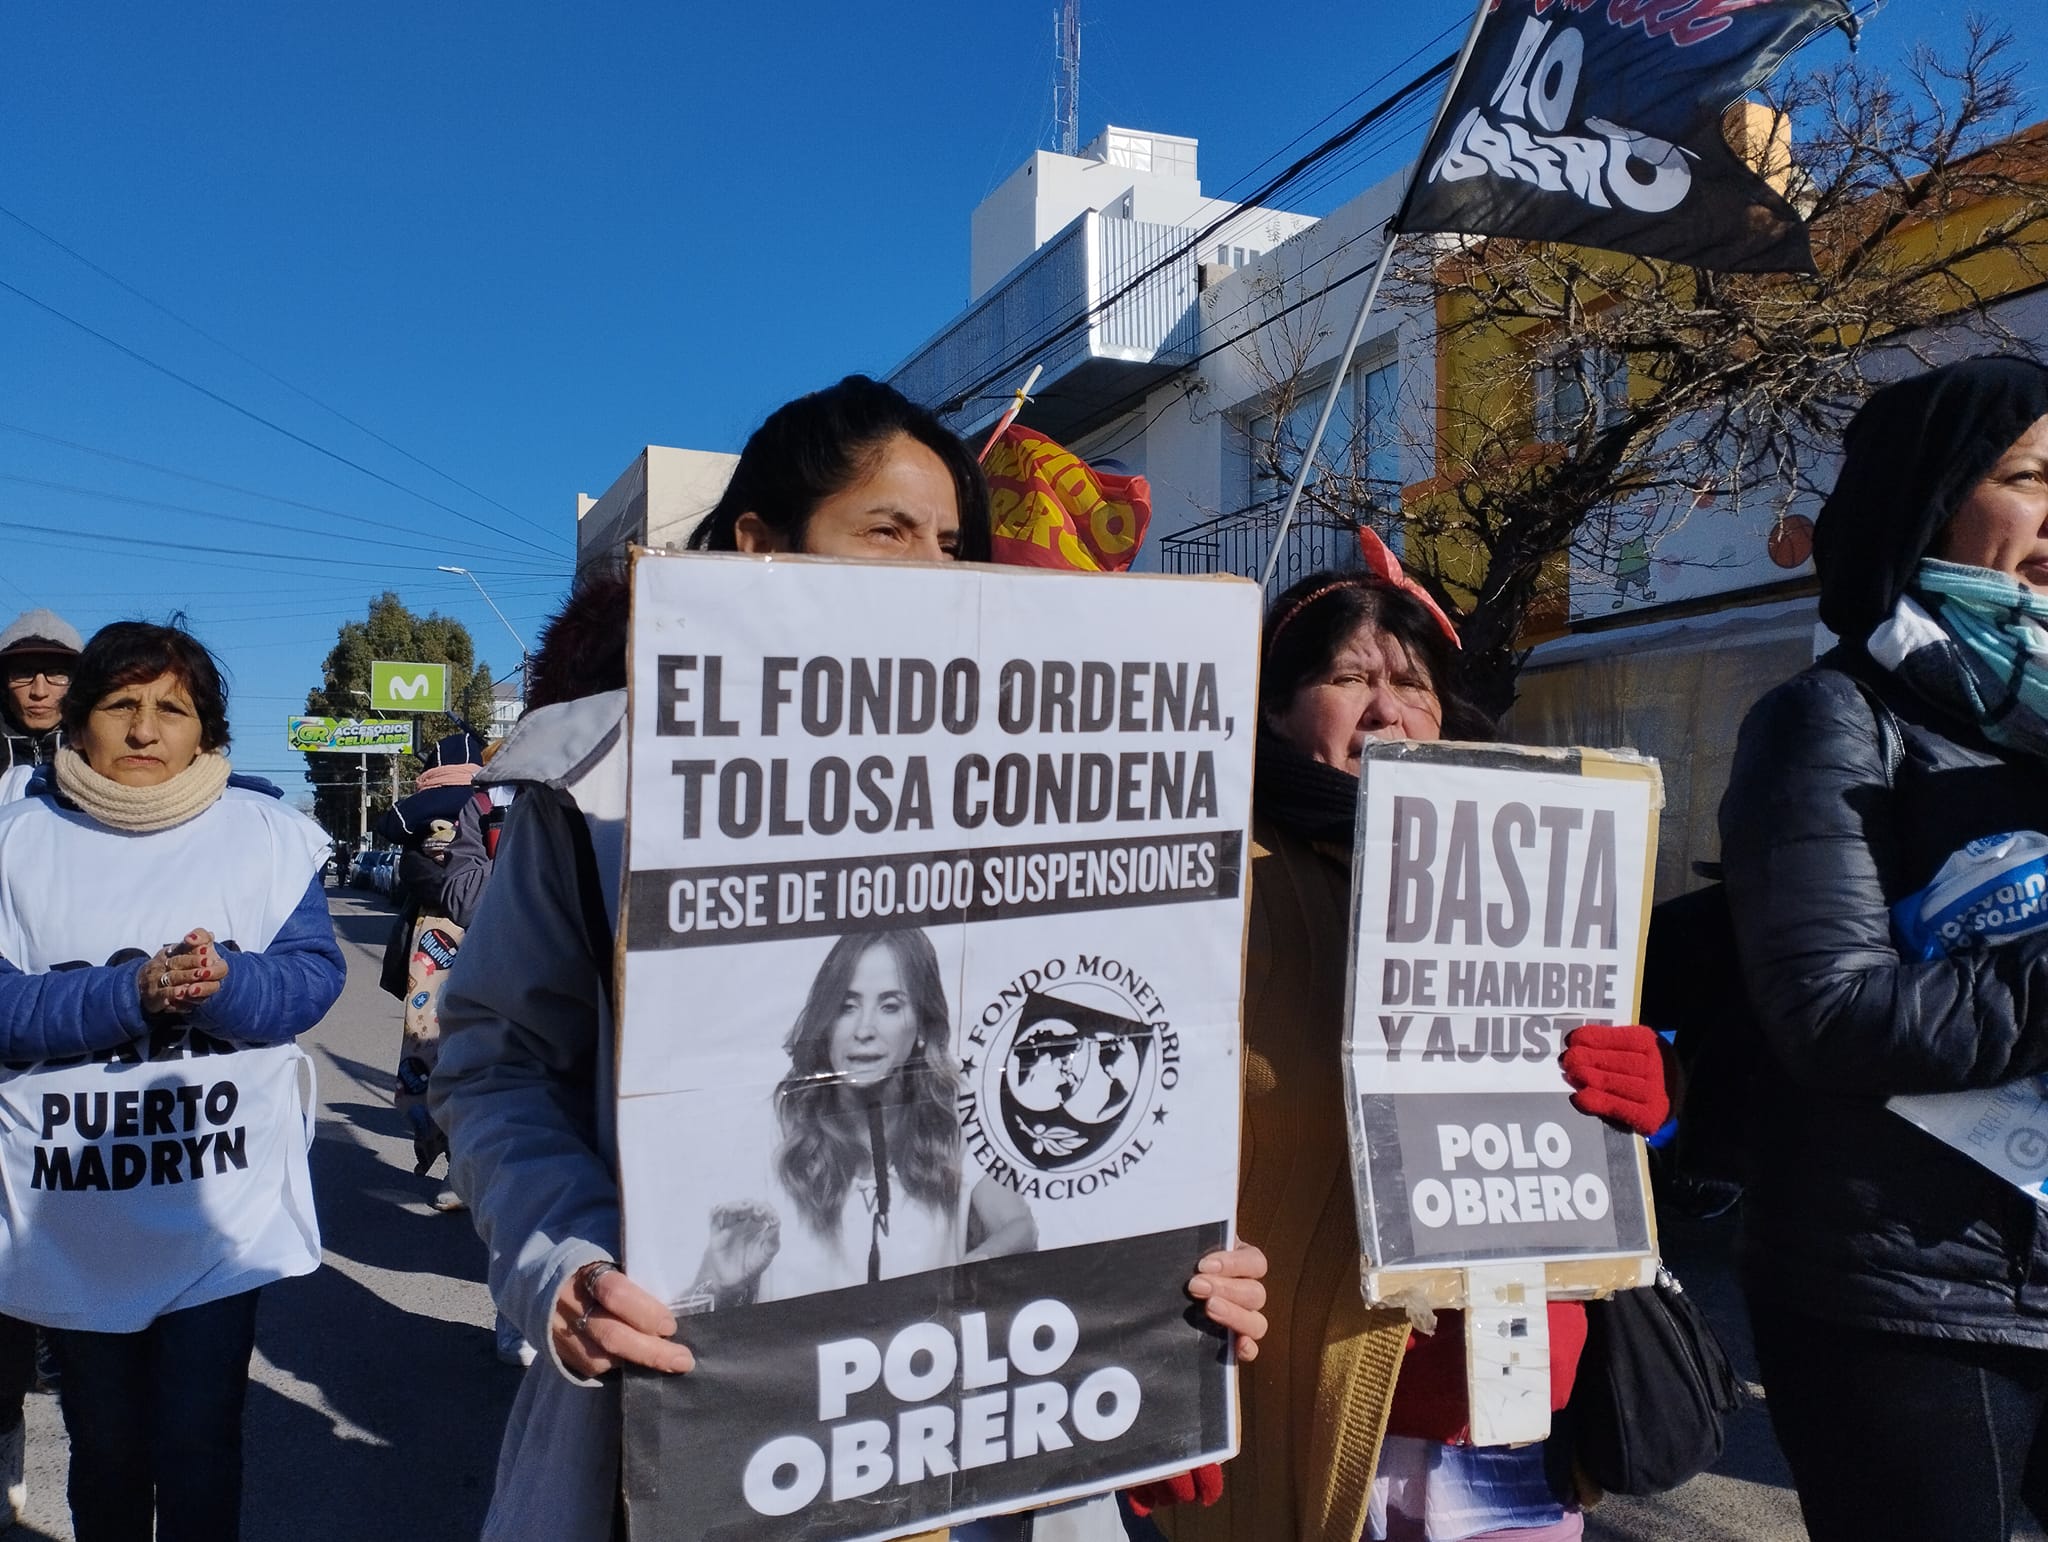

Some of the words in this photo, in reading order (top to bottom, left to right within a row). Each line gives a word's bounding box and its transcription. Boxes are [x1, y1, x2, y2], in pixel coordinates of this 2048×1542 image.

[334, 723, 411, 737] ACCESORIOS
[656, 655, 740, 736] EL
[761, 656, 979, 736] FONDO
[998, 659, 1235, 741] ORDENA,
[336, 733, 411, 747] CELULARES
[672, 754, 934, 839] TOLOSA
[953, 750, 1218, 828] CONDENA
[668, 874, 767, 933] CESE
[777, 872, 826, 923] DE
[836, 859, 975, 920] 160.000
[981, 842, 1216, 905] SUSPENSIONES
[1386, 795, 1618, 950] BASTA
[421, 931, 454, 969] CAMPING
[1382, 959, 1437, 1006] DE
[1447, 961, 1617, 1010] HAMBRE
[968, 958, 1067, 1048] FONDO
[1075, 954, 1181, 1091] MONETARIO
[1378, 1015, 1414, 1062] Y
[1421, 1015, 1614, 1063] AJUST
[41, 1081, 239, 1140] PUERTO
[30, 1126, 248, 1191] MADRYN
[958, 1091, 1153, 1201] INTERNACIONAL
[1437, 1121, 1571, 1171] POLO
[1412, 1174, 1610, 1229] OBRERO
[817, 1299, 1079, 1421] POLO
[742, 1366, 1142, 1516] OBRERO
